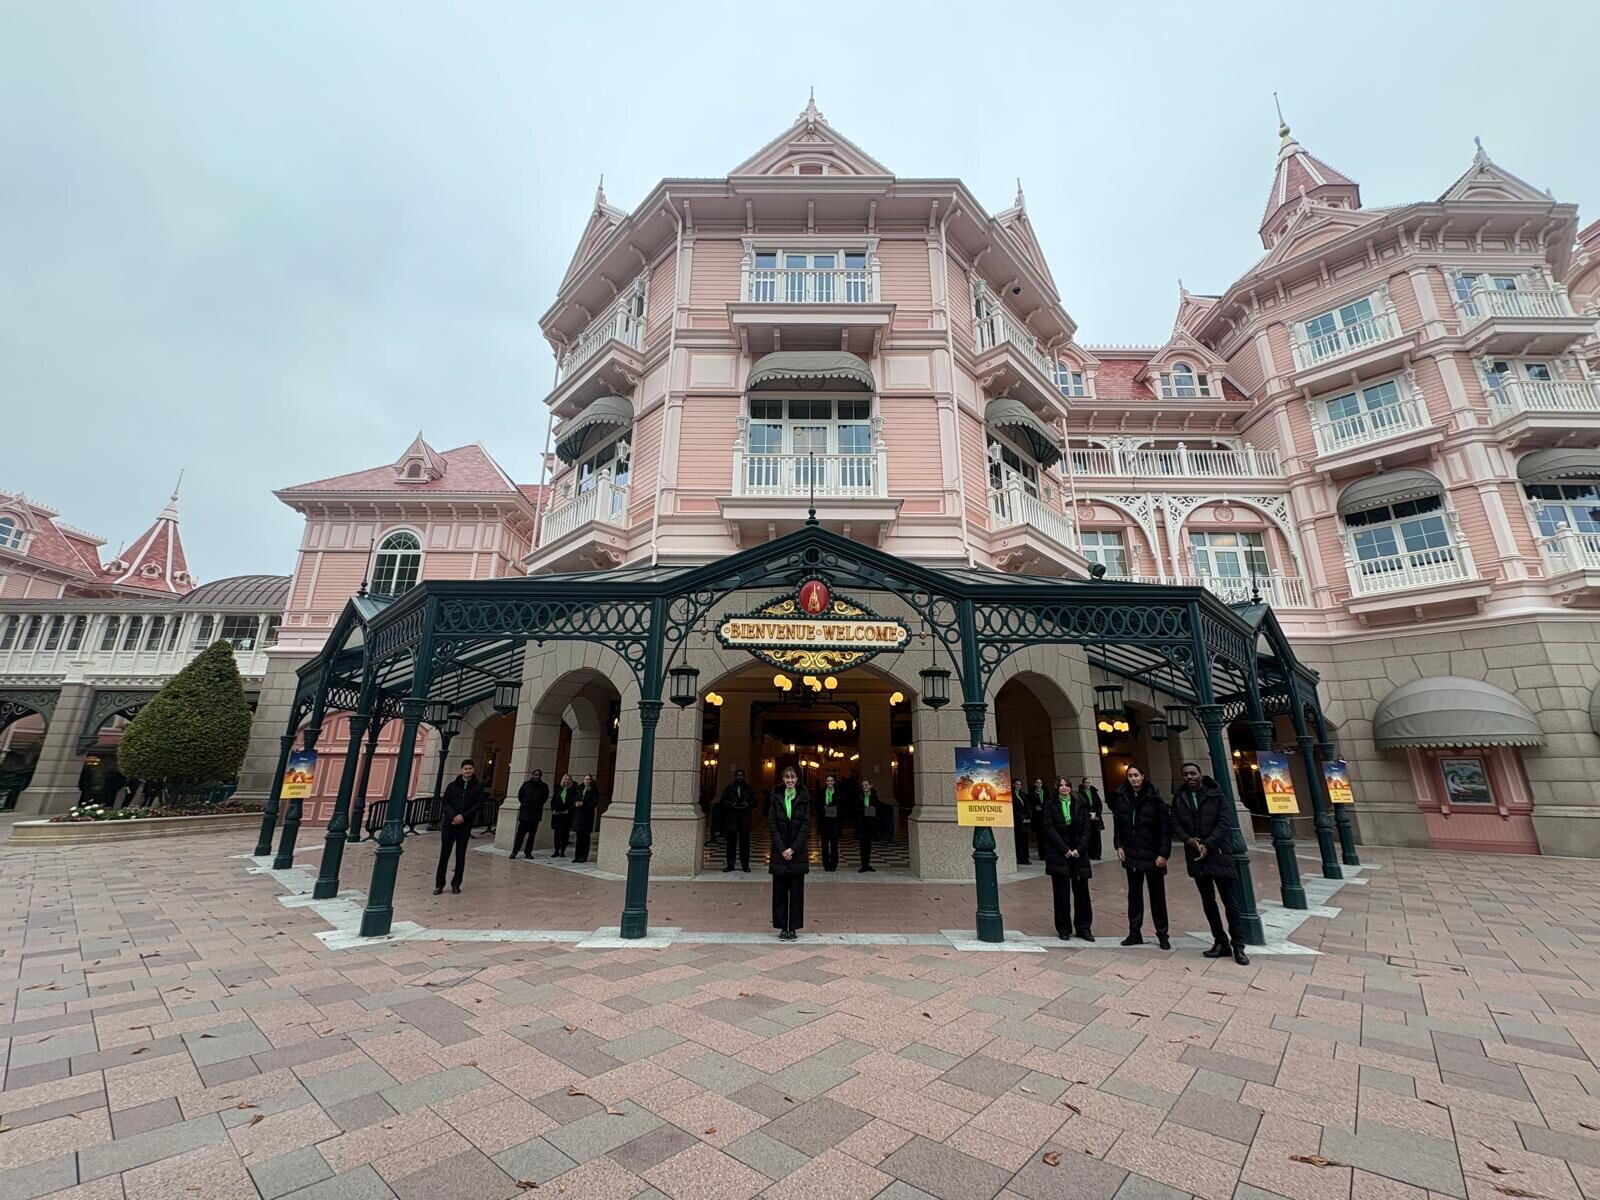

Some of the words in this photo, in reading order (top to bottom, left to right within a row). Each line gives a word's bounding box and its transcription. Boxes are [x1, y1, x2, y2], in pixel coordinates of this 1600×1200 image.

[730, 622, 815, 641] BIENVENUE
[822, 624, 899, 642] WELCOME
[968, 804, 1003, 813] BIENVENUE
